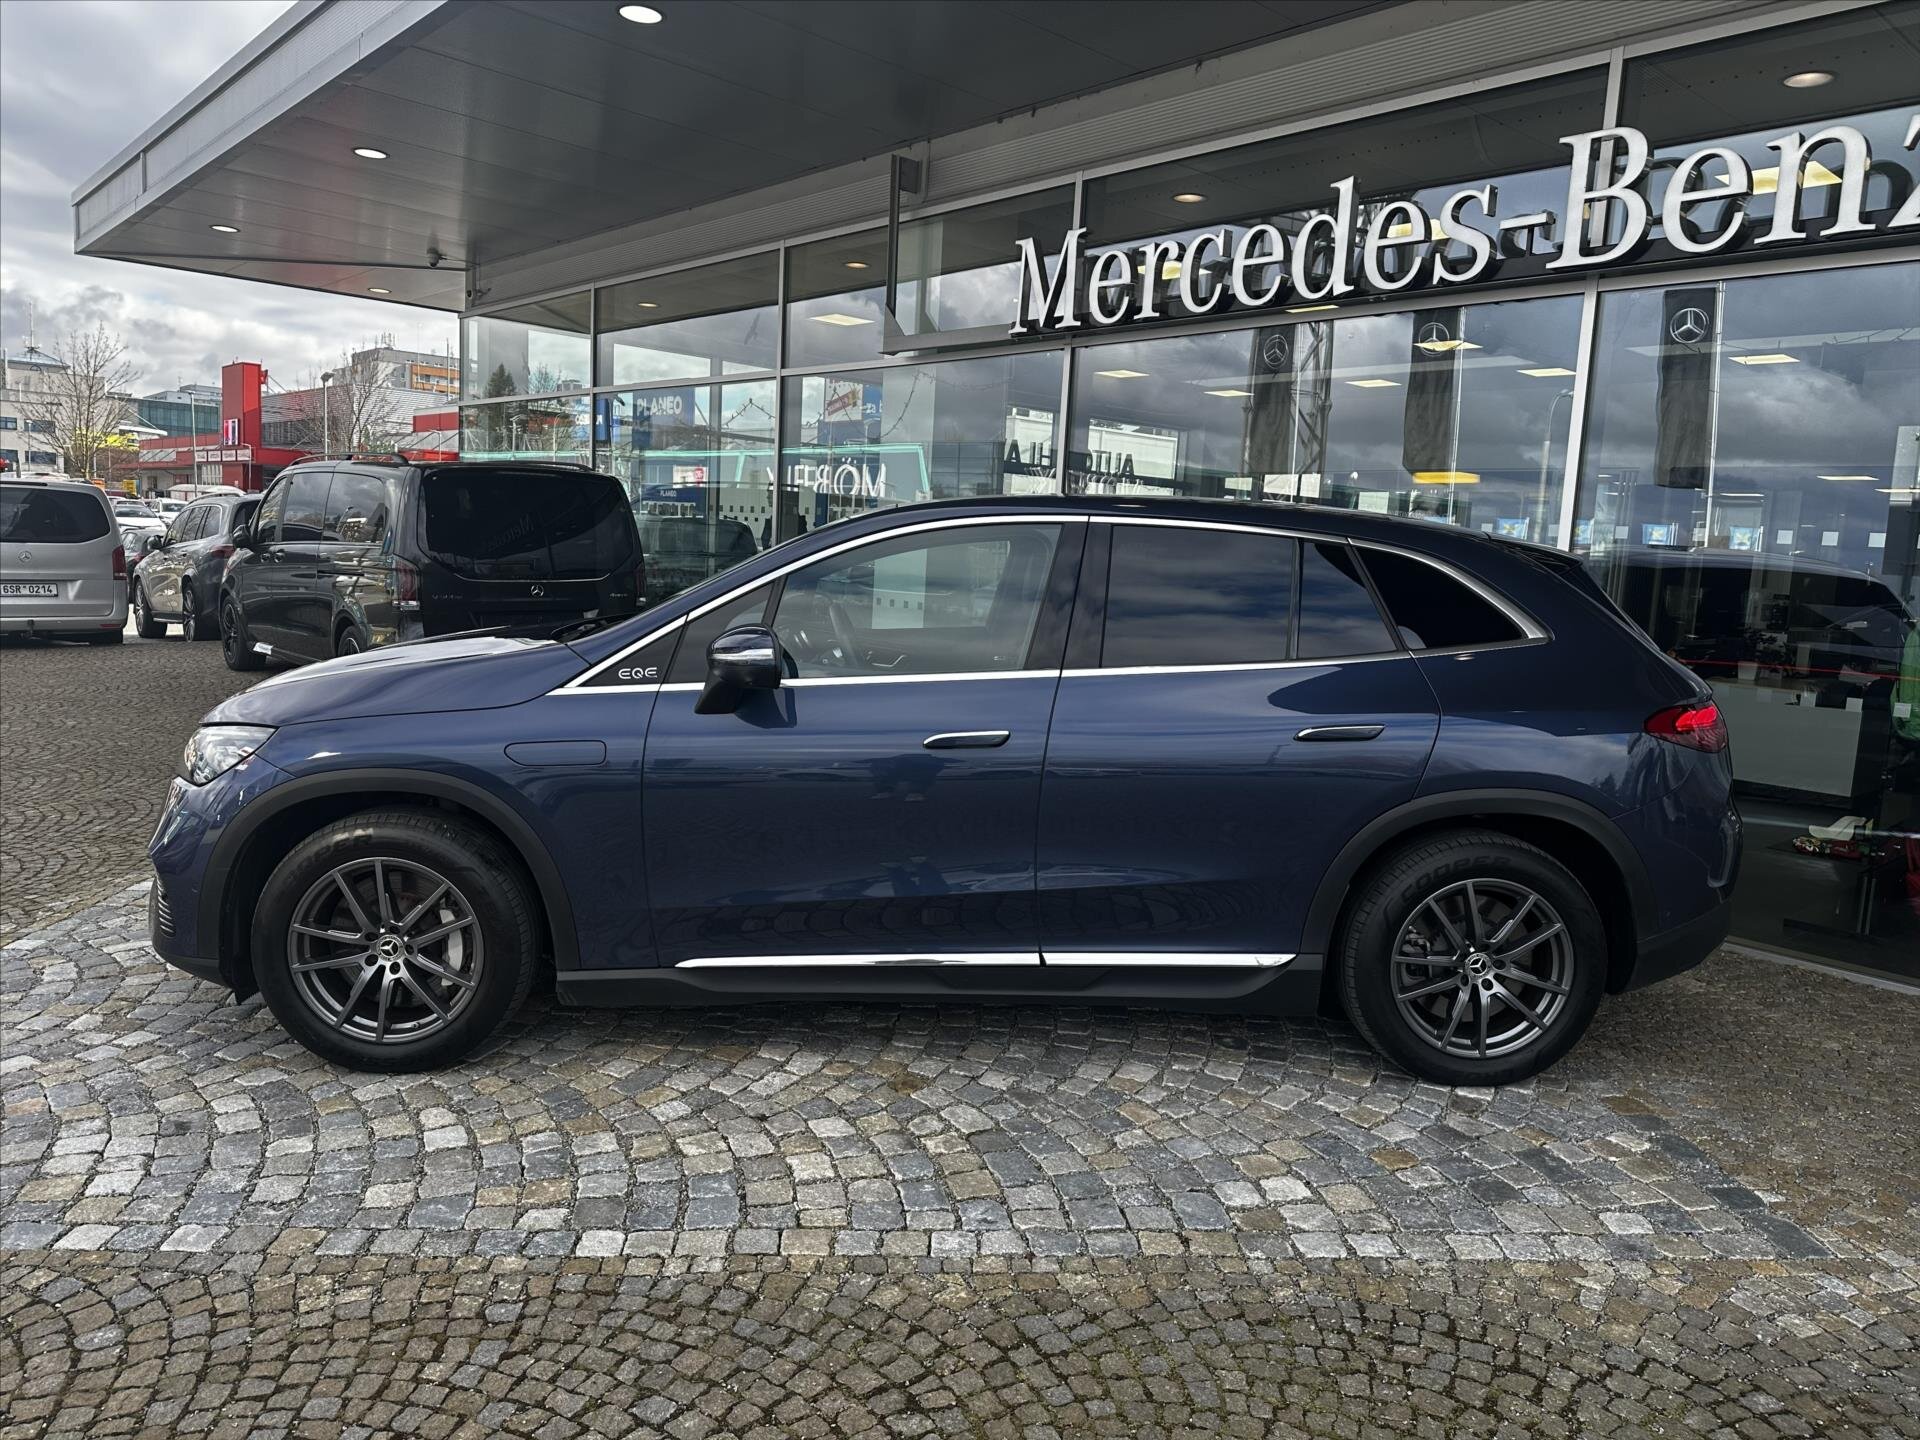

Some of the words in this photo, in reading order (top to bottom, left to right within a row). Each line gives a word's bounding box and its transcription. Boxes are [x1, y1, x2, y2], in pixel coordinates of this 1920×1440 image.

[636, 395, 683, 416] PLANEO
[2, 585, 22, 594] 6SR
[28, 585, 53, 594] 0214
[618, 666, 658, 679] EQE
